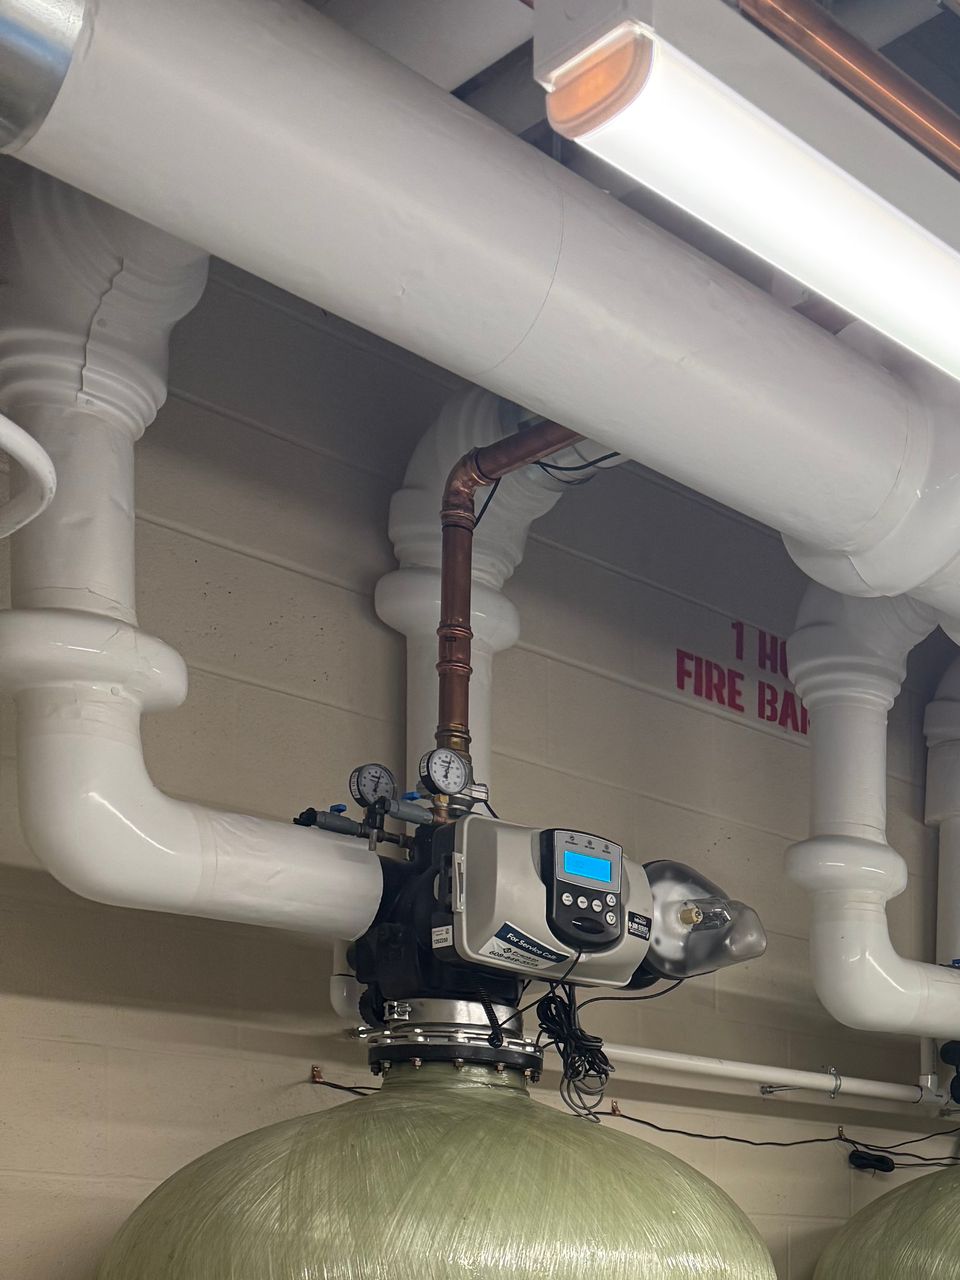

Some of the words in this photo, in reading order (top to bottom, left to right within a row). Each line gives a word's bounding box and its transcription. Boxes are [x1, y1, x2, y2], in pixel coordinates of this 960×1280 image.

[731, 620, 744, 661] 1
[676, 648, 745, 713] FIRE
[506, 932, 519, 943] For
[519, 939, 543, 955] Service
